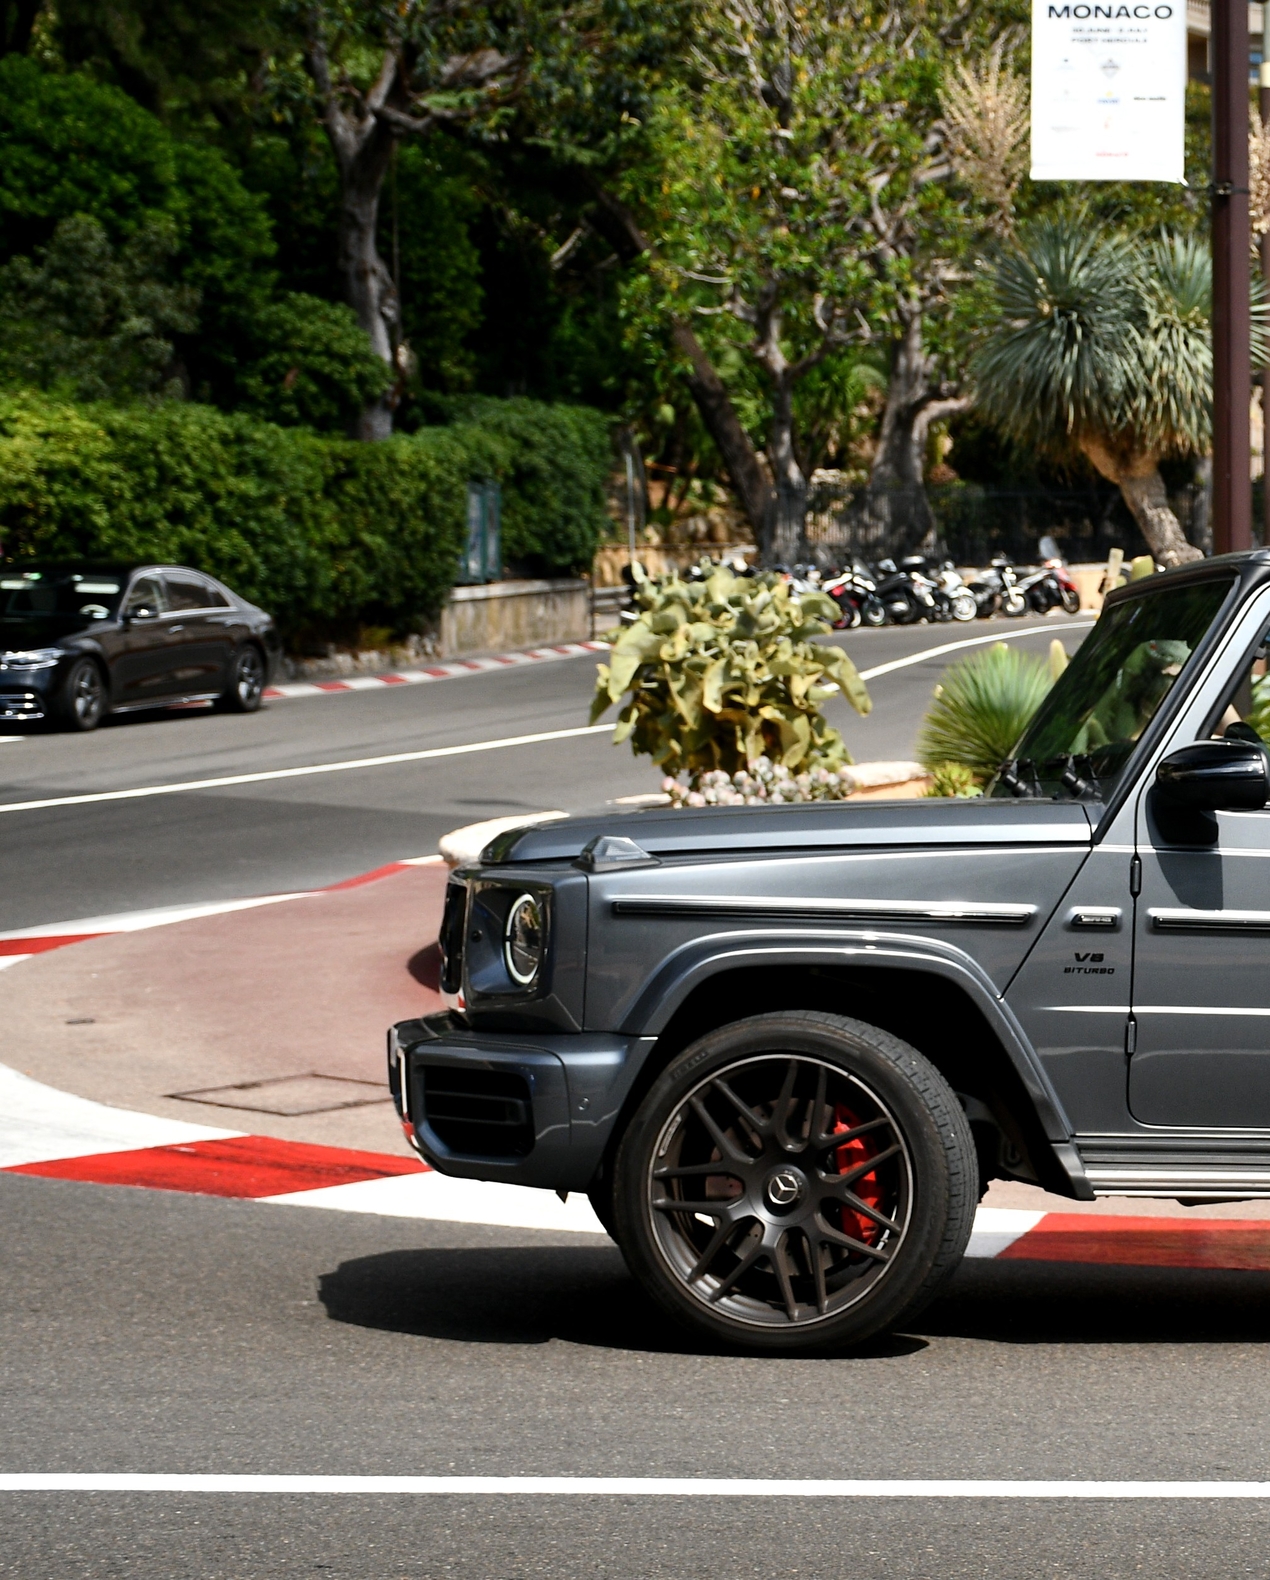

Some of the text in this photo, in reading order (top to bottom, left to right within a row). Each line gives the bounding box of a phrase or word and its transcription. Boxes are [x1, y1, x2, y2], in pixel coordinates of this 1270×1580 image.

[1048, 4, 1173, 19] MONACO
[1074, 952, 1105, 963] V8
[1063, 966, 1116, 975] BITURBO
